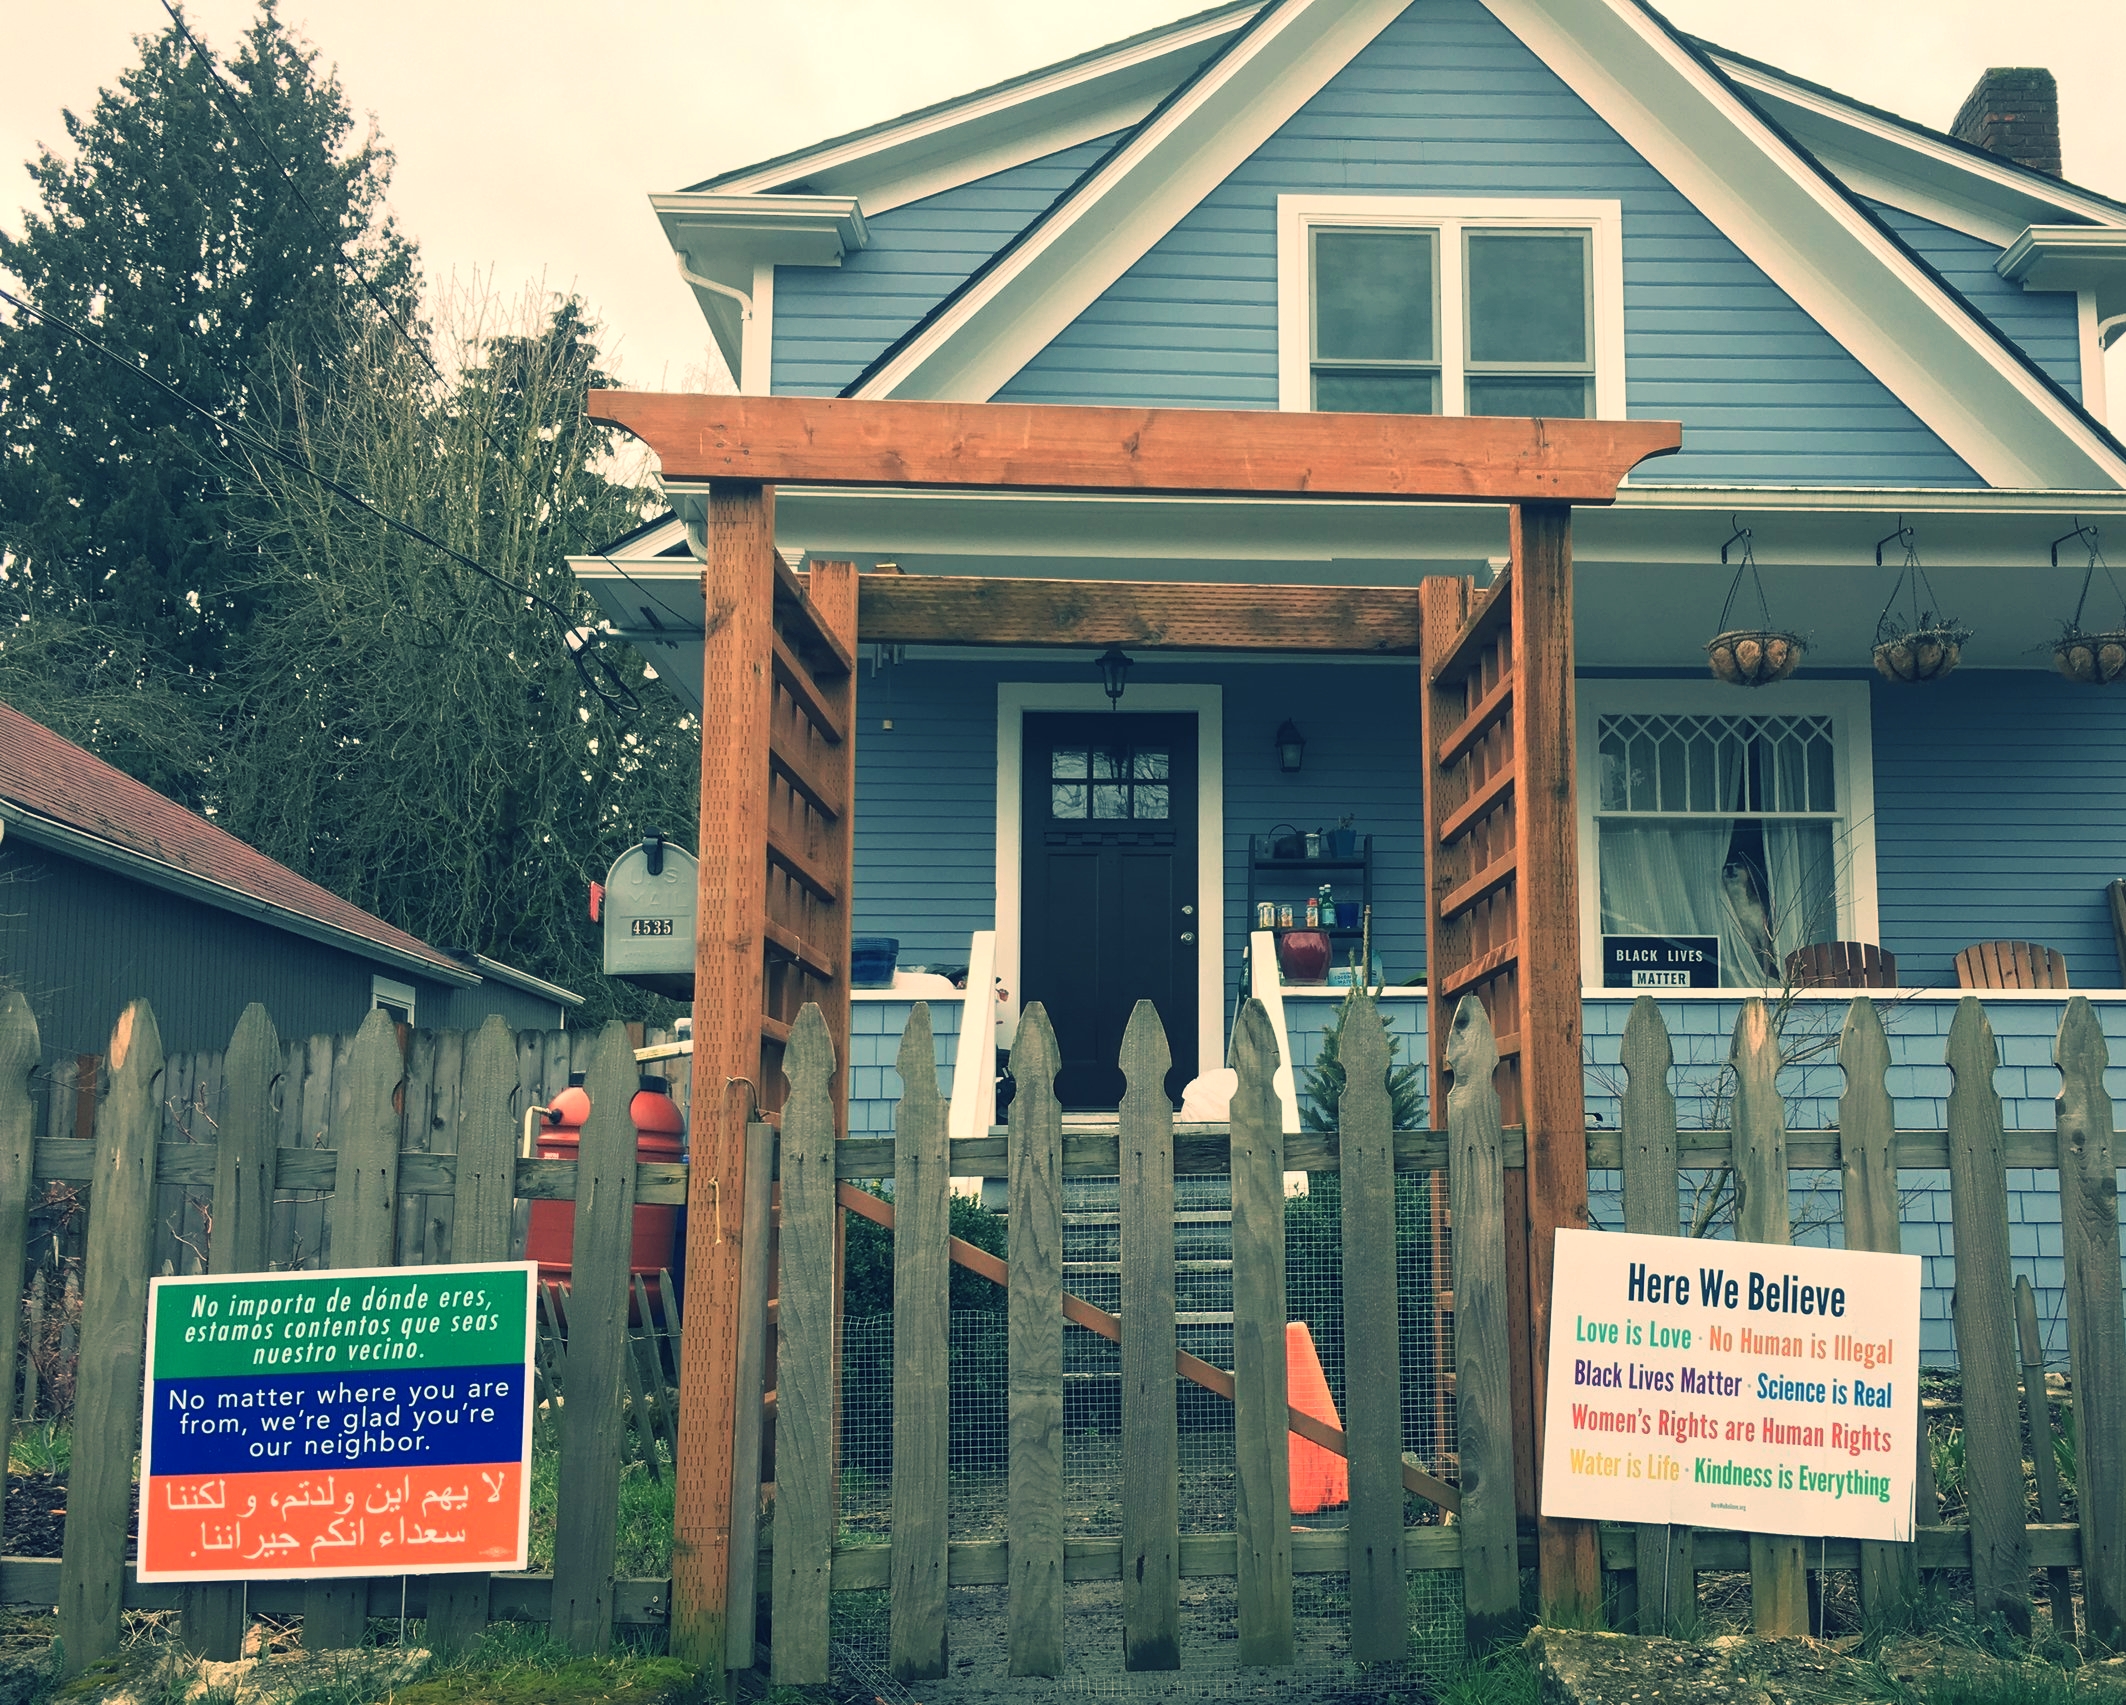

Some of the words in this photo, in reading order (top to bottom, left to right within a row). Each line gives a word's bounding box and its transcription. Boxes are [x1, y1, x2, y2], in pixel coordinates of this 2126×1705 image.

[633, 920, 671, 935] 4535
[1616, 949, 1658, 962] BLACK
[1668, 950, 1703, 962] LIVES
[1637, 972, 1687, 985] MATTER
[192, 1295, 218, 1317] No
[228, 1294, 315, 1319] importa
[327, 1287, 350, 1312] de
[362, 1284, 428, 1311] dónde
[440, 1290, 491, 1310] eres,
[1629, 1263, 1689, 1305] Here
[1700, 1268, 1738, 1309] We
[1748, 1272, 1844, 1317] Believe
[185, 1322, 273, 1342] estamos
[285, 1316, 390, 1338] contentos
[401, 1317, 440, 1339] que
[451, 1314, 498, 1331] seas
[1577, 1315, 1618, 1344] Love
[1626, 1319, 1642, 1345] is
[1650, 1321, 1691, 1349] Love
[1710, 1325, 1732, 1352] No
[1741, 1328, 1802, 1357] Human
[1811, 1333, 1826, 1359] is
[1835, 1335, 1892, 1369] Illegal
[253, 1343, 336, 1364] nuestro
[349, 1338, 425, 1360] vecino.
[170, 1390, 204, 1409] No
[218, 1389, 304, 1408] matter
[317, 1382, 395, 1404] where
[409, 1385, 454, 1406] you
[469, 1382, 508, 1397] are
[1575, 1359, 1622, 1388] Black
[1629, 1363, 1674, 1392] Lives
[1681, 1367, 1742, 1396] Matter
[1757, 1373, 1825, 1403] Science
[1833, 1378, 1847, 1405] is
[1854, 1380, 1891, 1408] Real
[180, 1413, 246, 1435] from,
[261, 1410, 330, 1431] we’re
[344, 1406, 399, 1433] glad
[412, 1403, 494, 1430] you’re
[1573, 1403, 1651, 1434] Women’s
[1659, 1410, 1718, 1443] Rights
[1726, 1421, 1755, 1442] are
[1763, 1417, 1823, 1447] Human
[1832, 1423, 1891, 1456] Rights
[250, 1442, 292, 1457] our
[305, 1432, 431, 1459] neighbor.
[482, 1472, 504, 1502] لا
[1570, 1448, 1621, 1476] Water
[1627, 1453, 1641, 1478] is
[1648, 1454, 1679, 1481] Life
[1695, 1458, 1772, 1488] Kindness
[1779, 1464, 1793, 1489] is
[1799, 1465, 1890, 1502] Everything
[166, 1480, 225, 1510] لكننا
[366, 1475, 409, 1513] اين
[422, 1486, 468, 1517] يهم
[311, 1518, 364, 1561] انكم
[379, 1521, 465, 1547] سعداء
